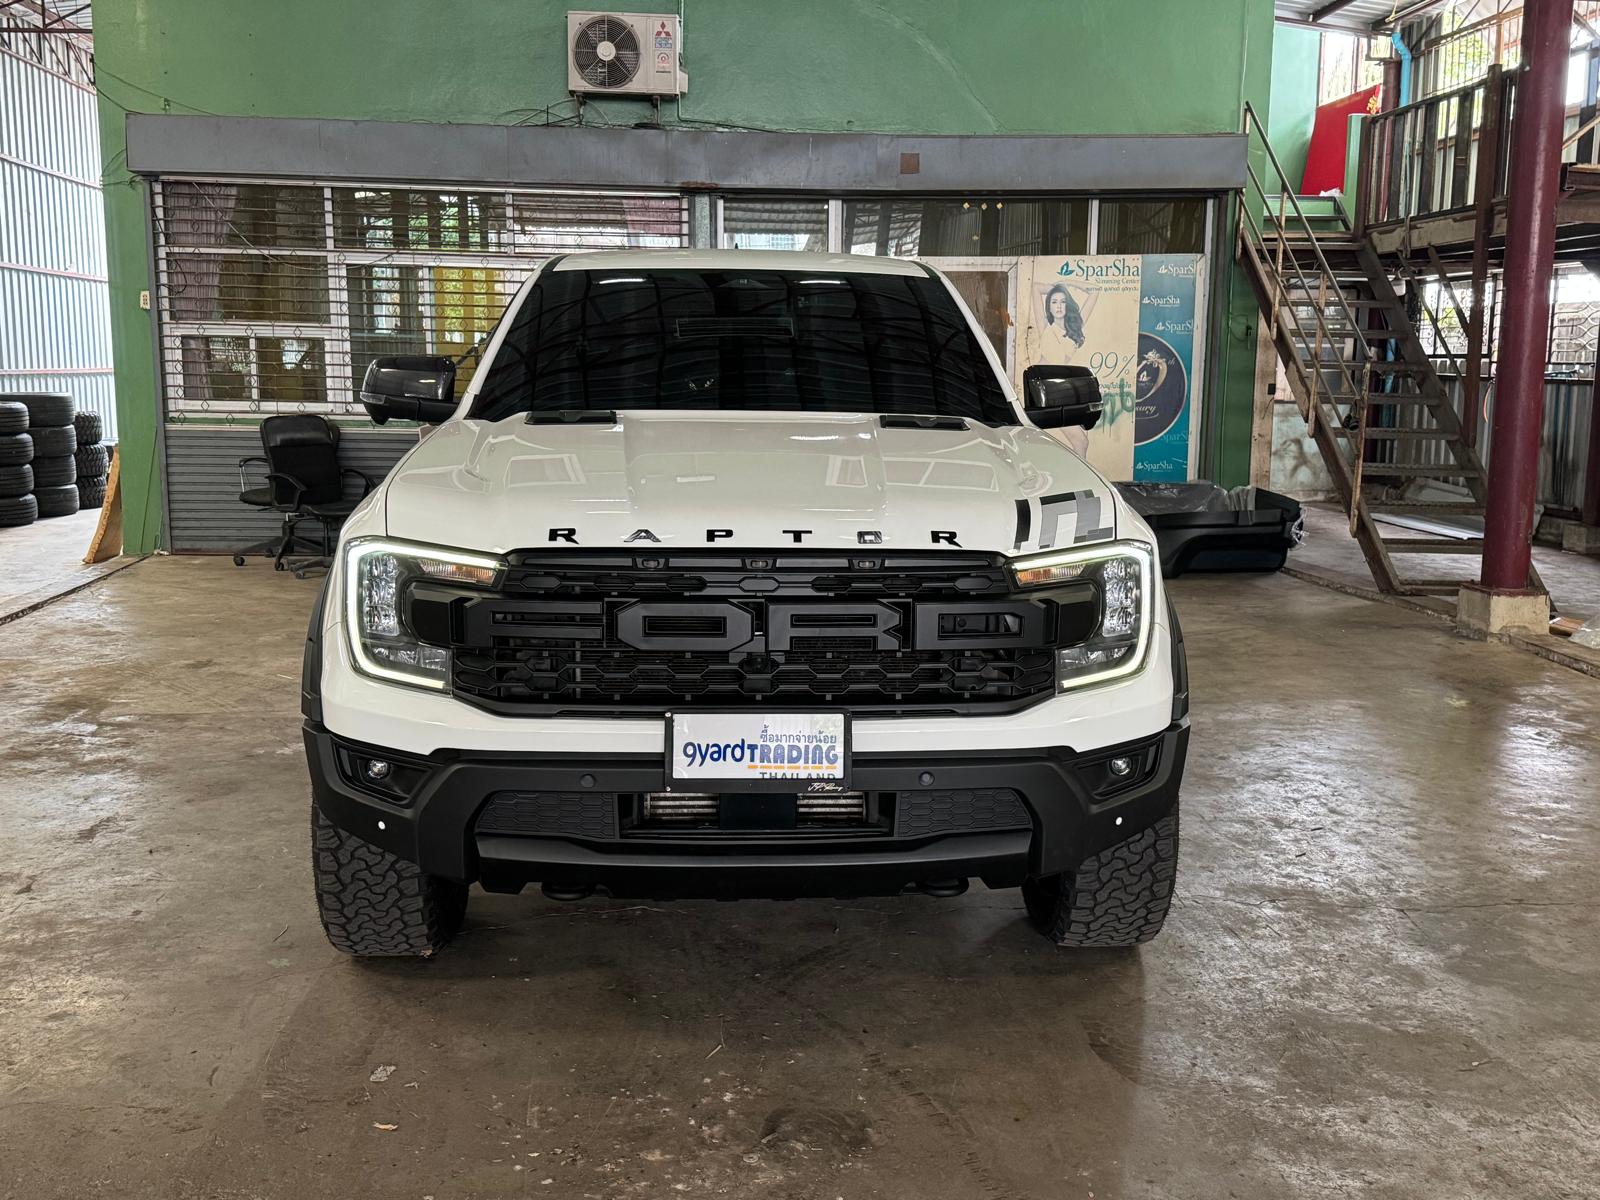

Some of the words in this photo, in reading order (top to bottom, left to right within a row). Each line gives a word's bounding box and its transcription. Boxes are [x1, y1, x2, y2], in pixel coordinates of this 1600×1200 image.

[1075, 258, 1140, 281] SparSha
[1150, 295, 1180, 306] SparSha
[1165, 319, 1194, 333] SparS
[1089, 351, 1136, 378] 99%
[1143, 460, 1173, 471] SparSha
[548, 527, 962, 549] RAPTOR
[464, 598, 1046, 652] FORD
[759, 724, 837, 744] ซื้อมากจ่ายน้อย
